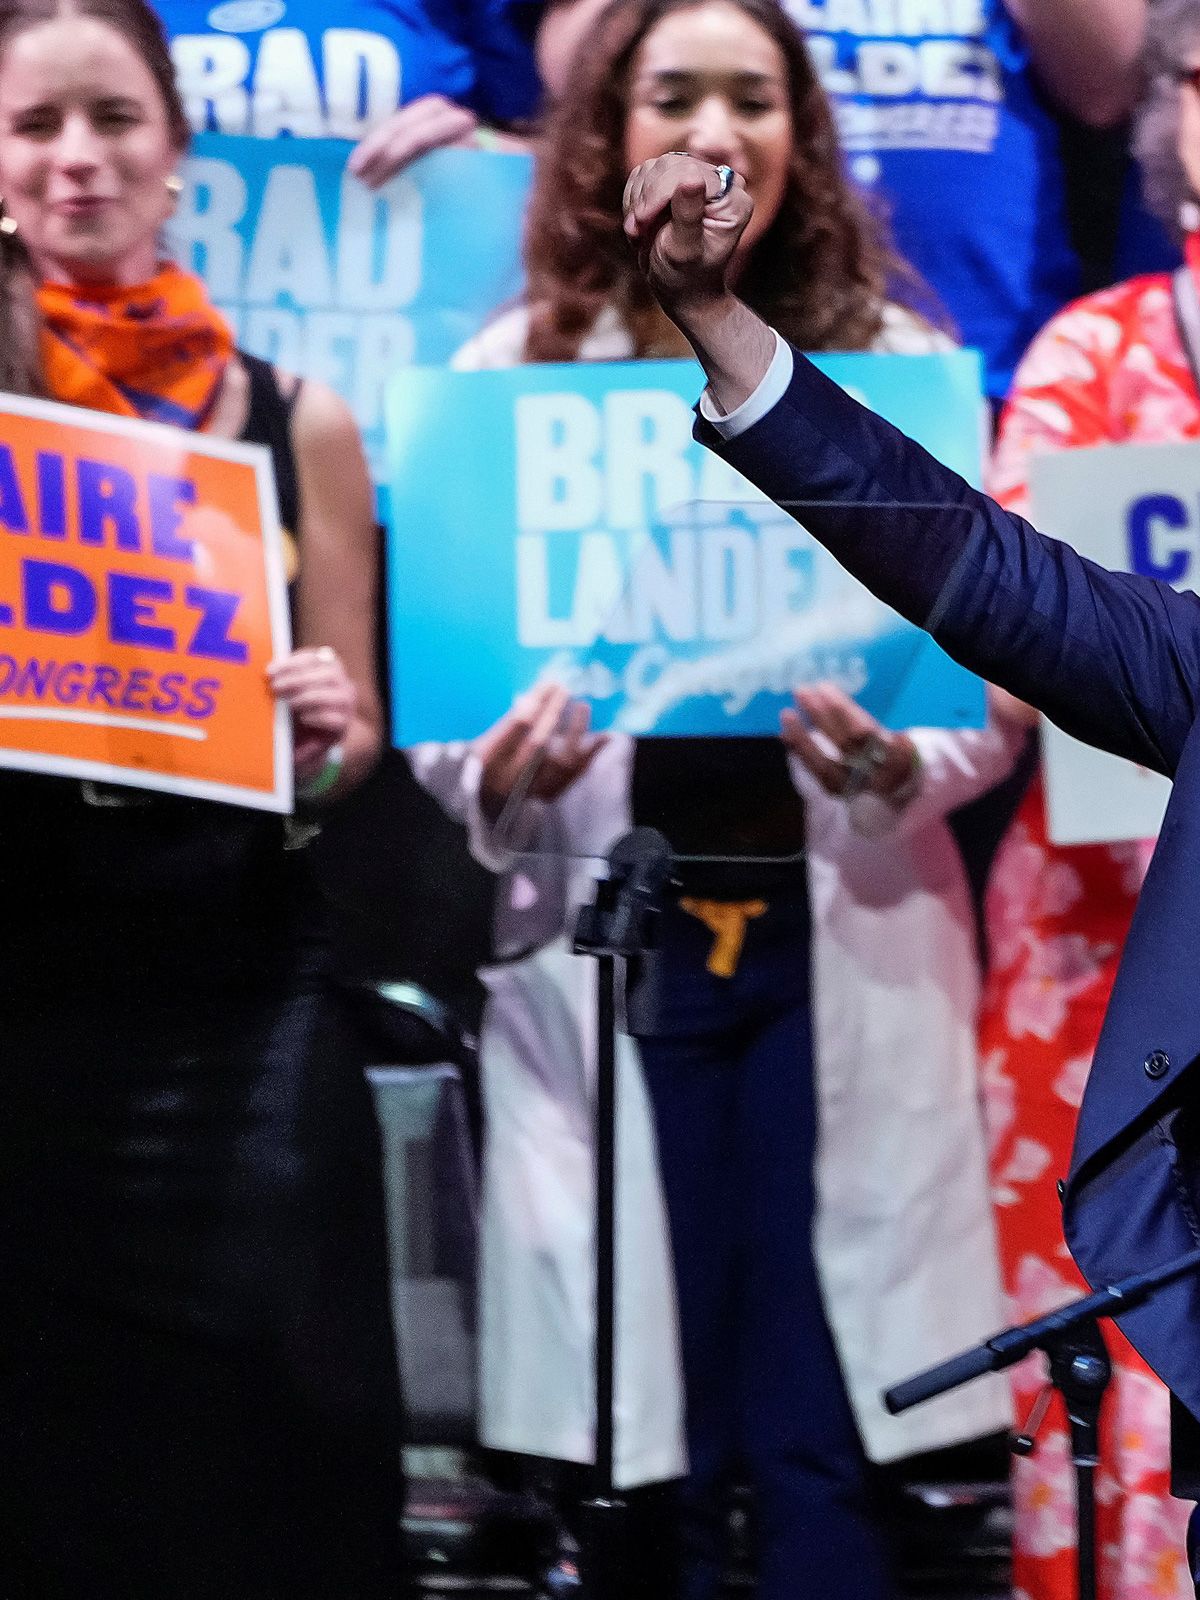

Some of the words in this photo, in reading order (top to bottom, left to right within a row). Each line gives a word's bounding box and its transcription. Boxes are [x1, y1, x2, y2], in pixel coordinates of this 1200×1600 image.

[173, 27, 401, 141] RAD
[513, 387, 872, 533] BRA
[0, 556, 251, 665] DEZ
